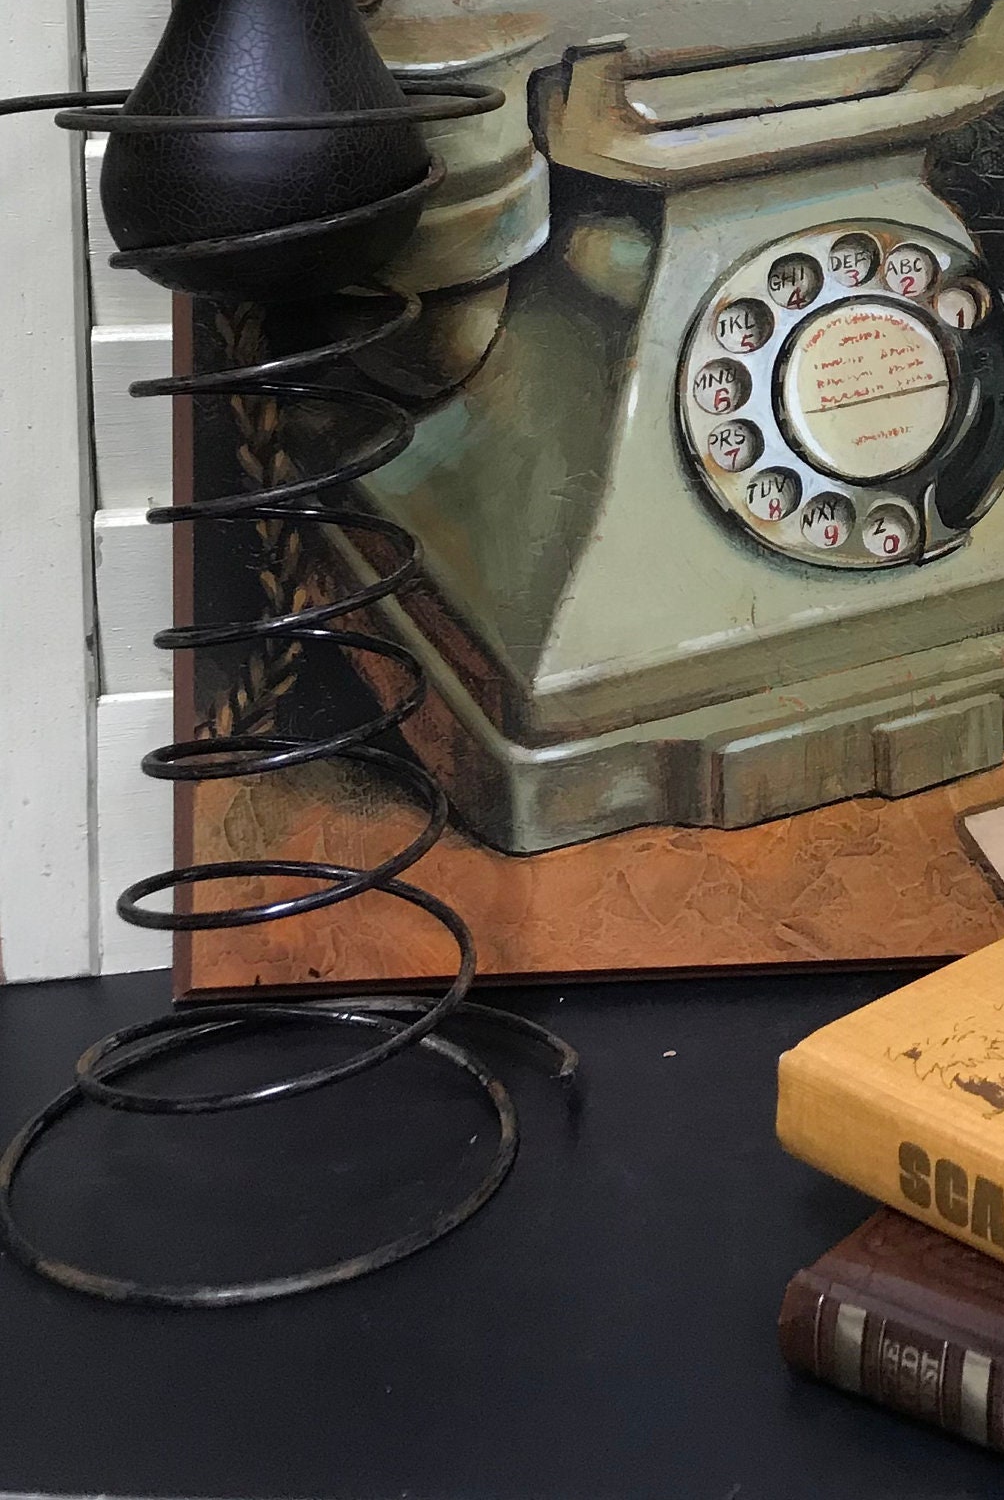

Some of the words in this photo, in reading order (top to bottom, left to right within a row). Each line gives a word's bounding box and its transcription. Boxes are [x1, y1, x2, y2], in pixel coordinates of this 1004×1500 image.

[830, 252, 869, 272] DEF
[886, 257, 922, 276] ABC
[770, 265, 805, 292] GHI
[844, 269, 861, 287] 3
[899, 275, 917, 297] 2
[787, 287, 807, 310] 4
[719, 313, 755, 337] JKL
[955, 307, 965, 328] 1
[740, 334, 756, 350] 5
[713, 387, 731, 412] 6
[724, 447, 741, 470] 7
[746, 475, 786, 504] TUV
[768, 498, 782, 520] 8
[824, 524, 839, 547] 9
[872, 516, 886, 536] Z
